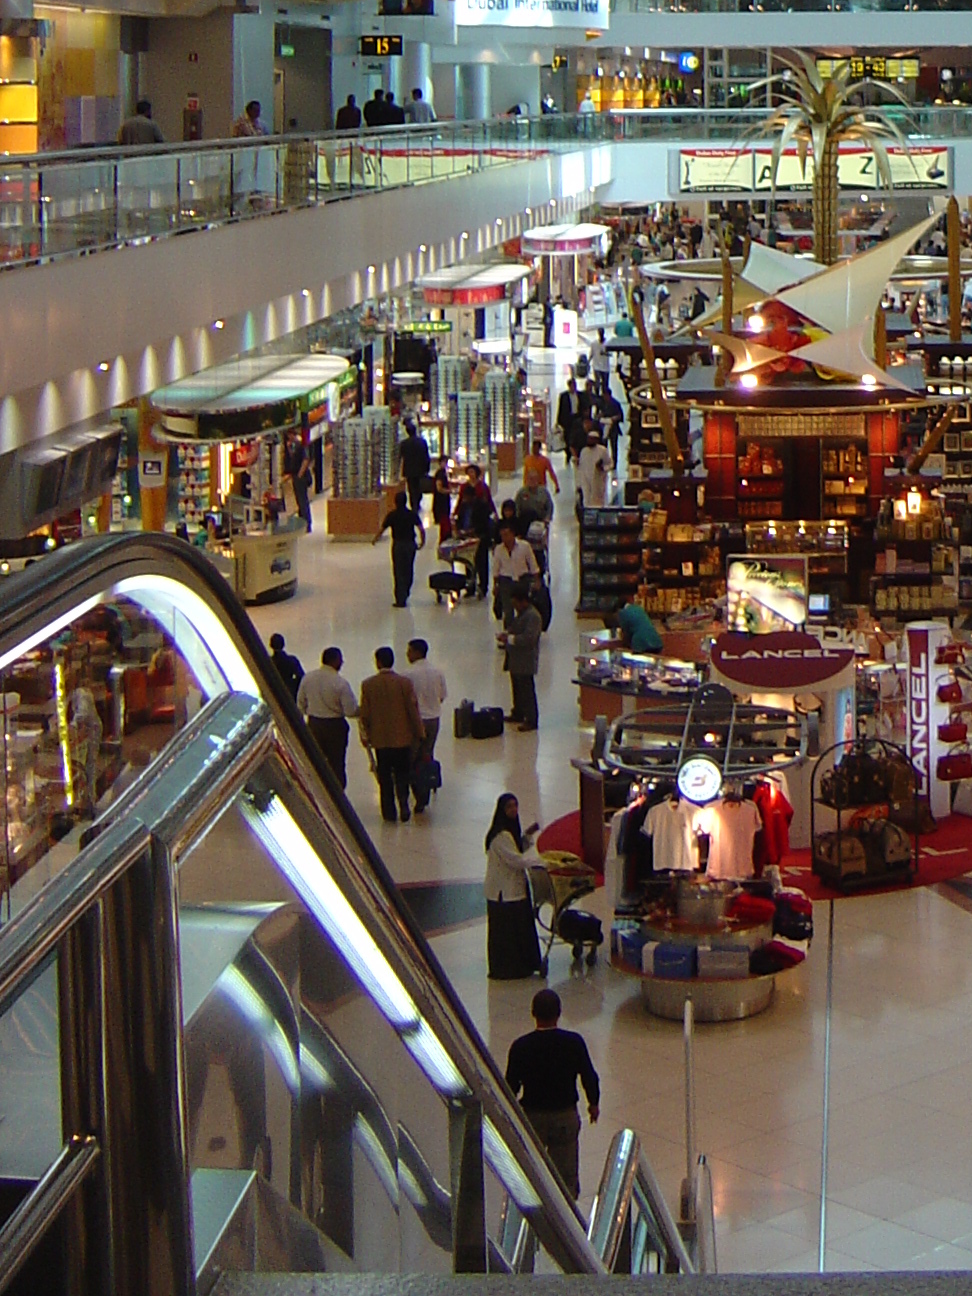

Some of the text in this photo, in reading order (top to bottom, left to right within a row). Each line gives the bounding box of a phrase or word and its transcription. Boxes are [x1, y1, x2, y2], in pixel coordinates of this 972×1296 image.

[376, 37, 389, 55] 15
[757, 165, 773, 184] A
[859, 155, 874, 175] Z
[720, 648, 840, 660] LANCEL
[911, 652, 928, 797] LANCEL
